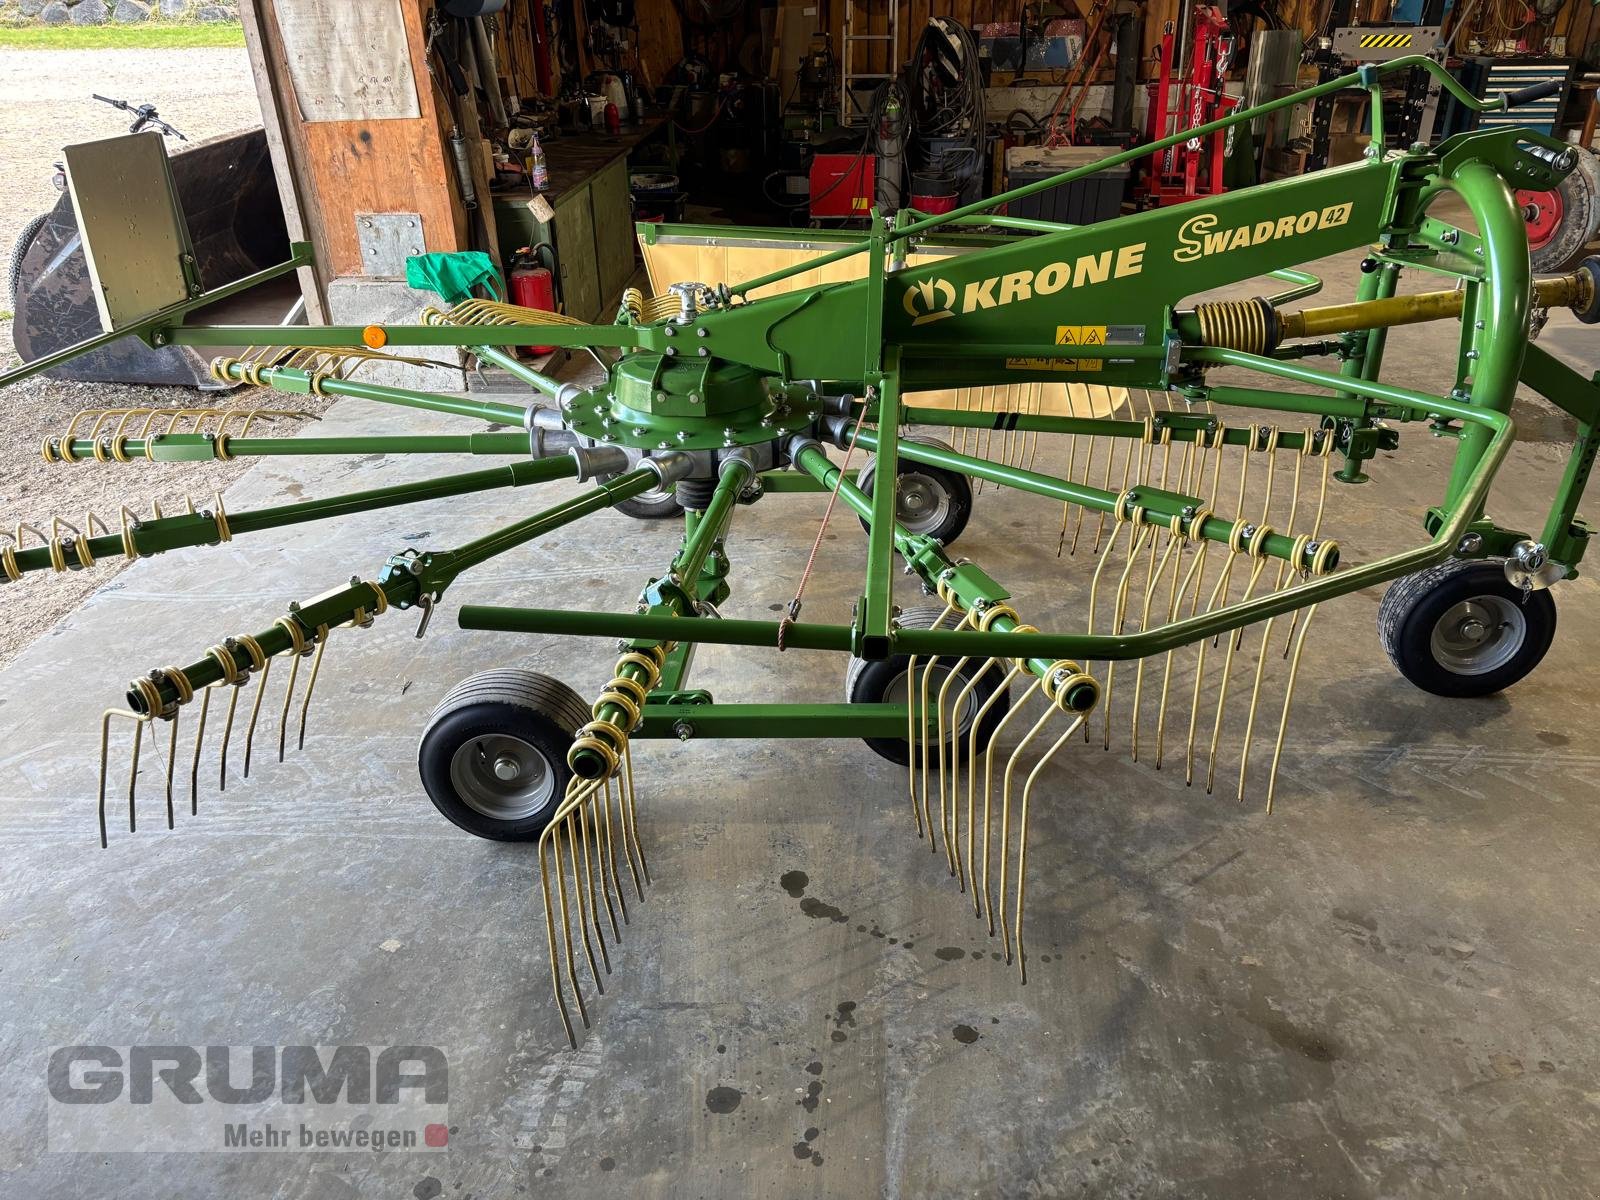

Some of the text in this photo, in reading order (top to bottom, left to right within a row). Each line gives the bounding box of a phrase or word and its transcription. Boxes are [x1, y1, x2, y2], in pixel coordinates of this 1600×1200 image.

[1173, 207, 1343, 262] SWADRO 42
[962, 242, 1147, 313] KRONE
